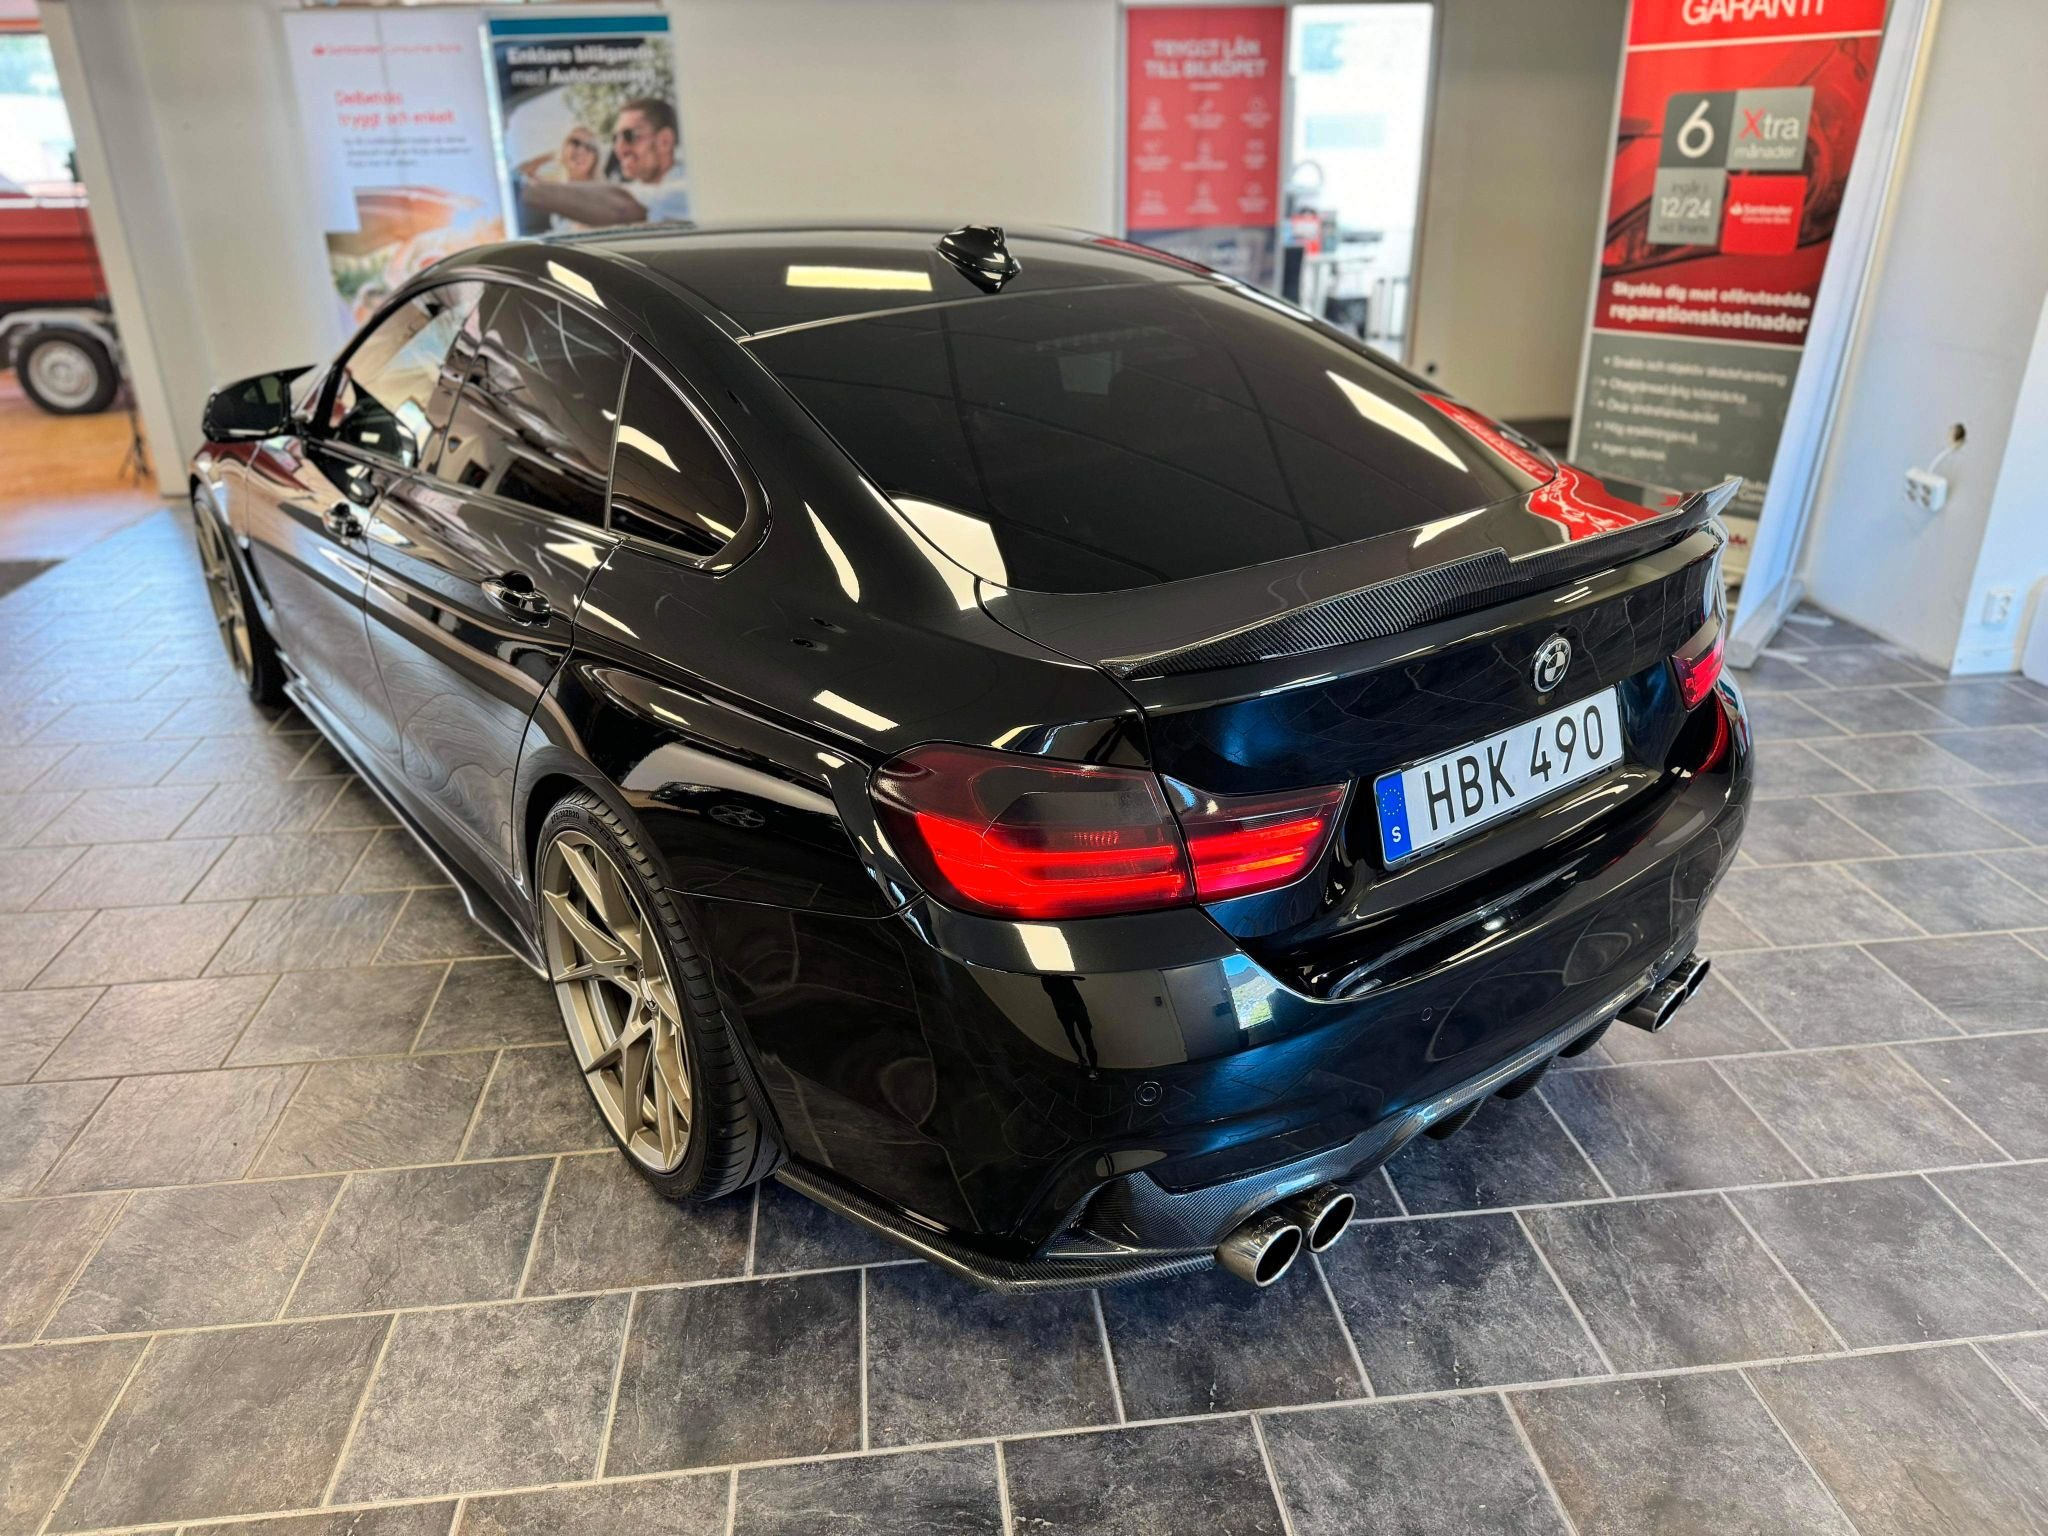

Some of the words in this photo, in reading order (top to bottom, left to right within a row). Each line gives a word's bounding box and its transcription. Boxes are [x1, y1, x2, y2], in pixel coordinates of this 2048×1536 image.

[506, 45, 572, 65] Enklare
[1221, 35, 1261, 57] LÅN
[511, 68, 547, 85] med
[1143, 59, 1181, 79] TILL
[1183, 58, 1267, 79] BILKÖPET
[1677, 98, 1714, 159] 6
[1740, 108, 1800, 140] Xtra
[1734, 143, 1796, 160] månader
[1660, 197, 1712, 219] 12/24
[1743, 203, 1793, 216] Santander
[1612, 280, 1663, 301] Skydda
[1664, 284, 1687, 304] dig
[1688, 286, 1718, 302] mot
[1719, 288, 1810, 309] oförutsedda
[1609, 303, 1808, 333] reparationskostnader
[1424, 739, 1515, 831] HBK
[1530, 704, 1604, 782] 490
[1391, 825, 1402, 843] S
